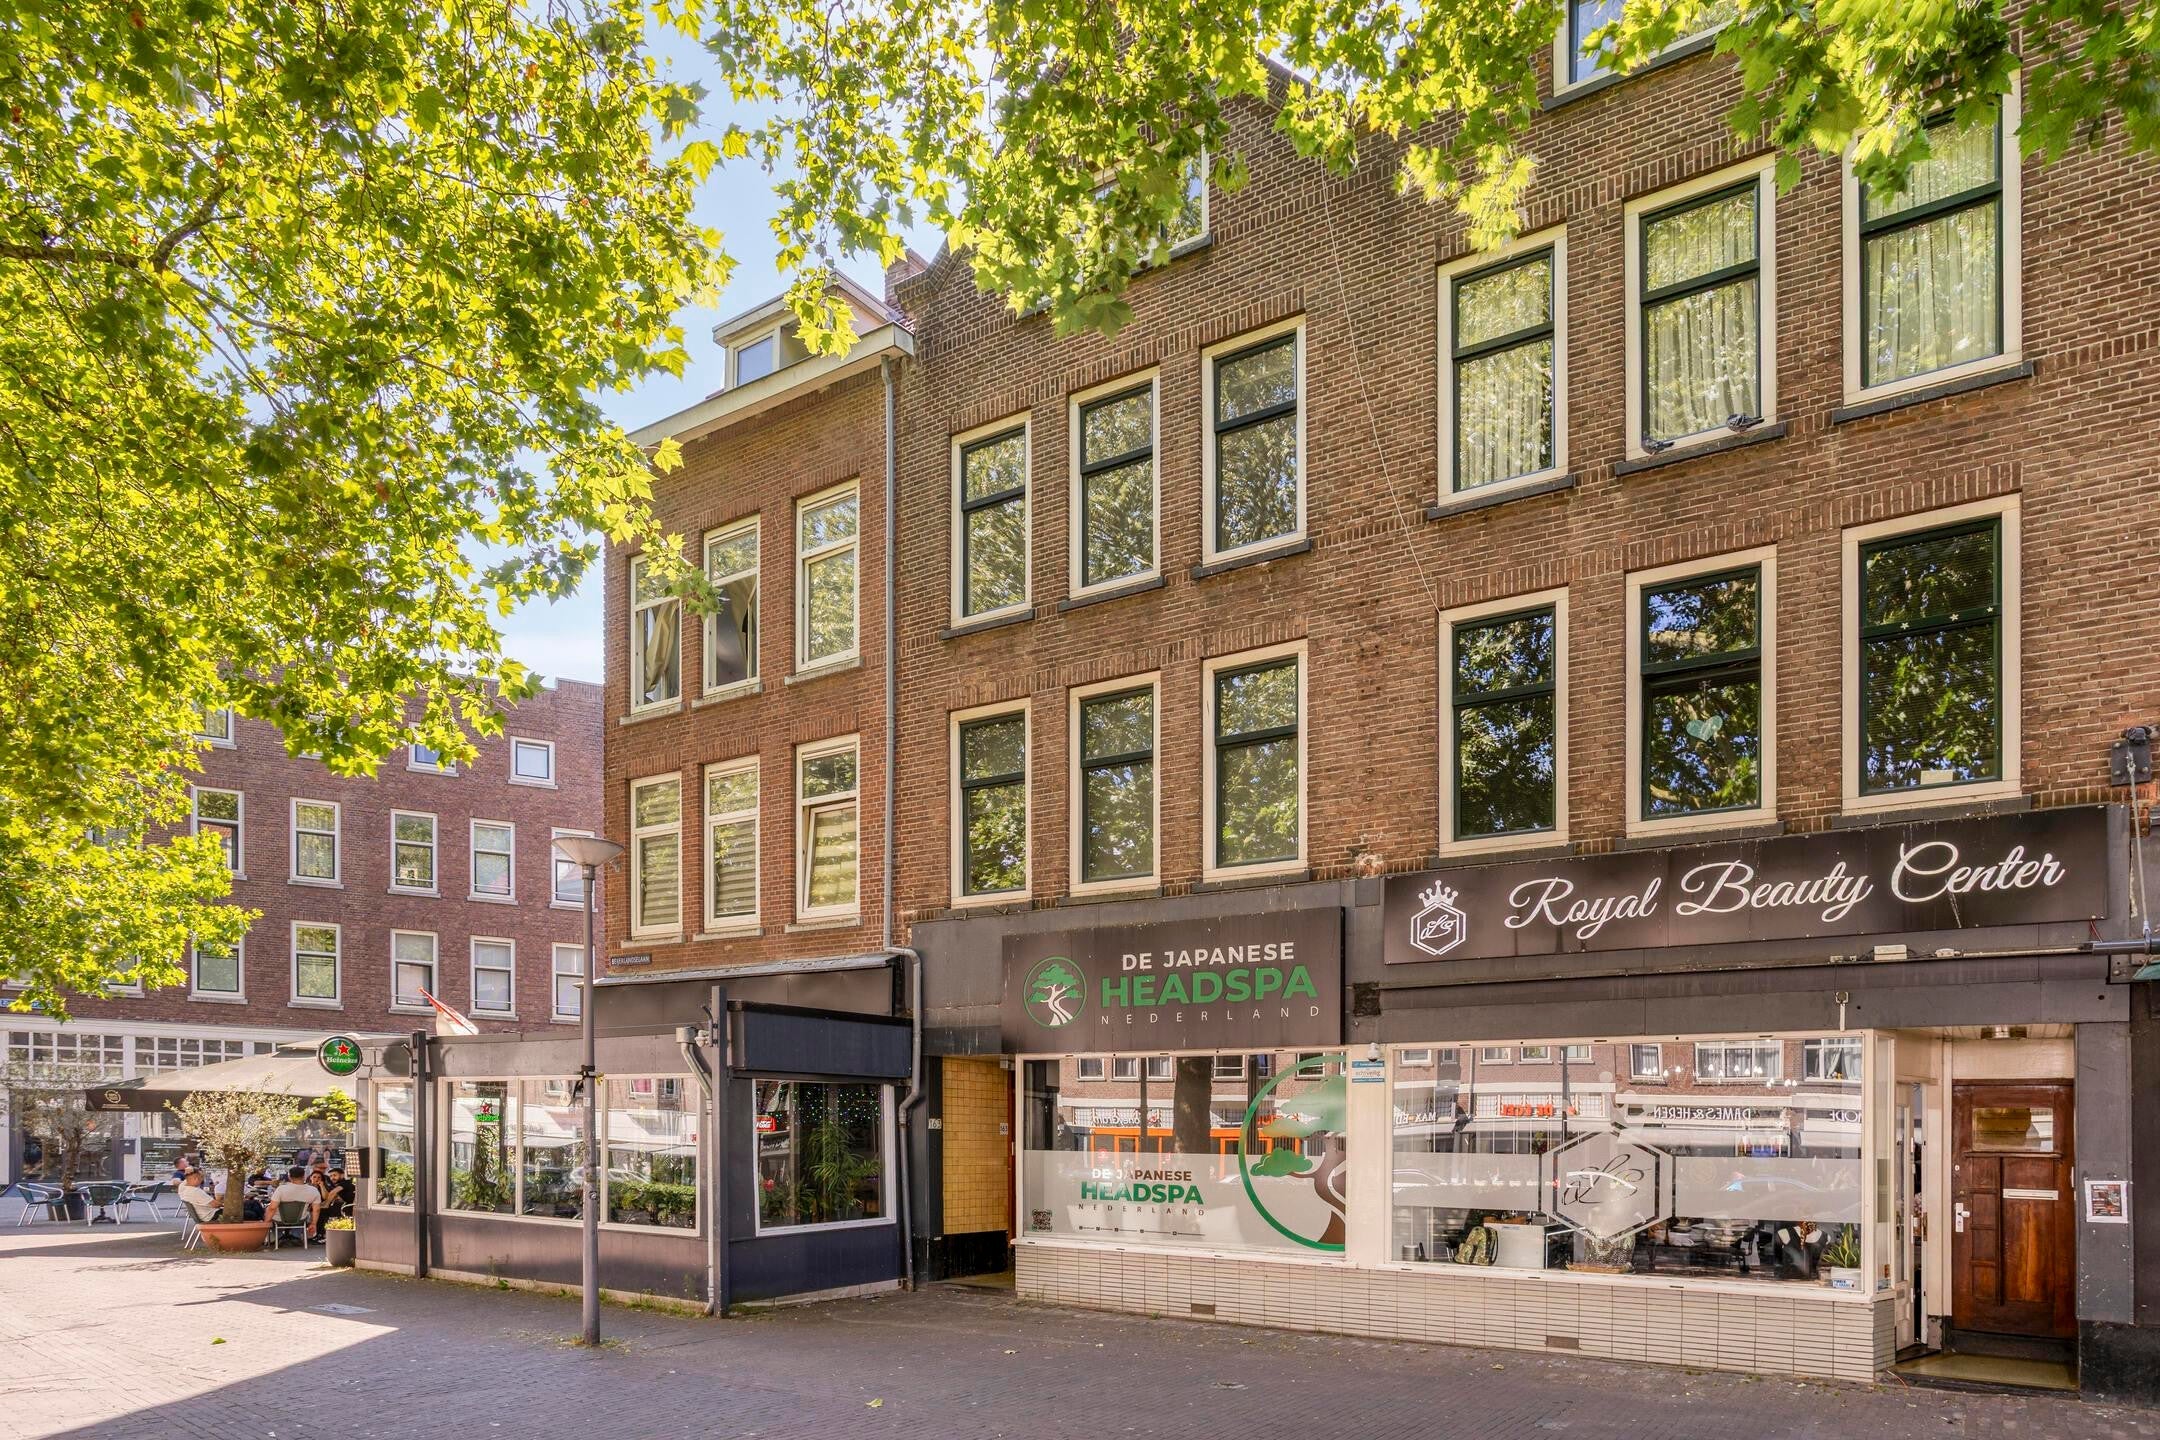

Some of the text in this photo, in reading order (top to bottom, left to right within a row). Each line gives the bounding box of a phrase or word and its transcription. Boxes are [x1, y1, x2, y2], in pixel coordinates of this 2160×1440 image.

[1504, 877, 1662, 940] Royal
[1677, 860, 1873, 923] Beauty
[1892, 840, 2065, 903] Center
[1122, 942, 1295, 971] DE JAPANESE
[1100, 964, 1319, 1008] HEADSPA
[1101, 1005, 1320, 1025] NEDERLAND
[1116, 1169, 1192, 1181] JAPANESE
[1081, 1181, 1204, 1205] HEADSPA
